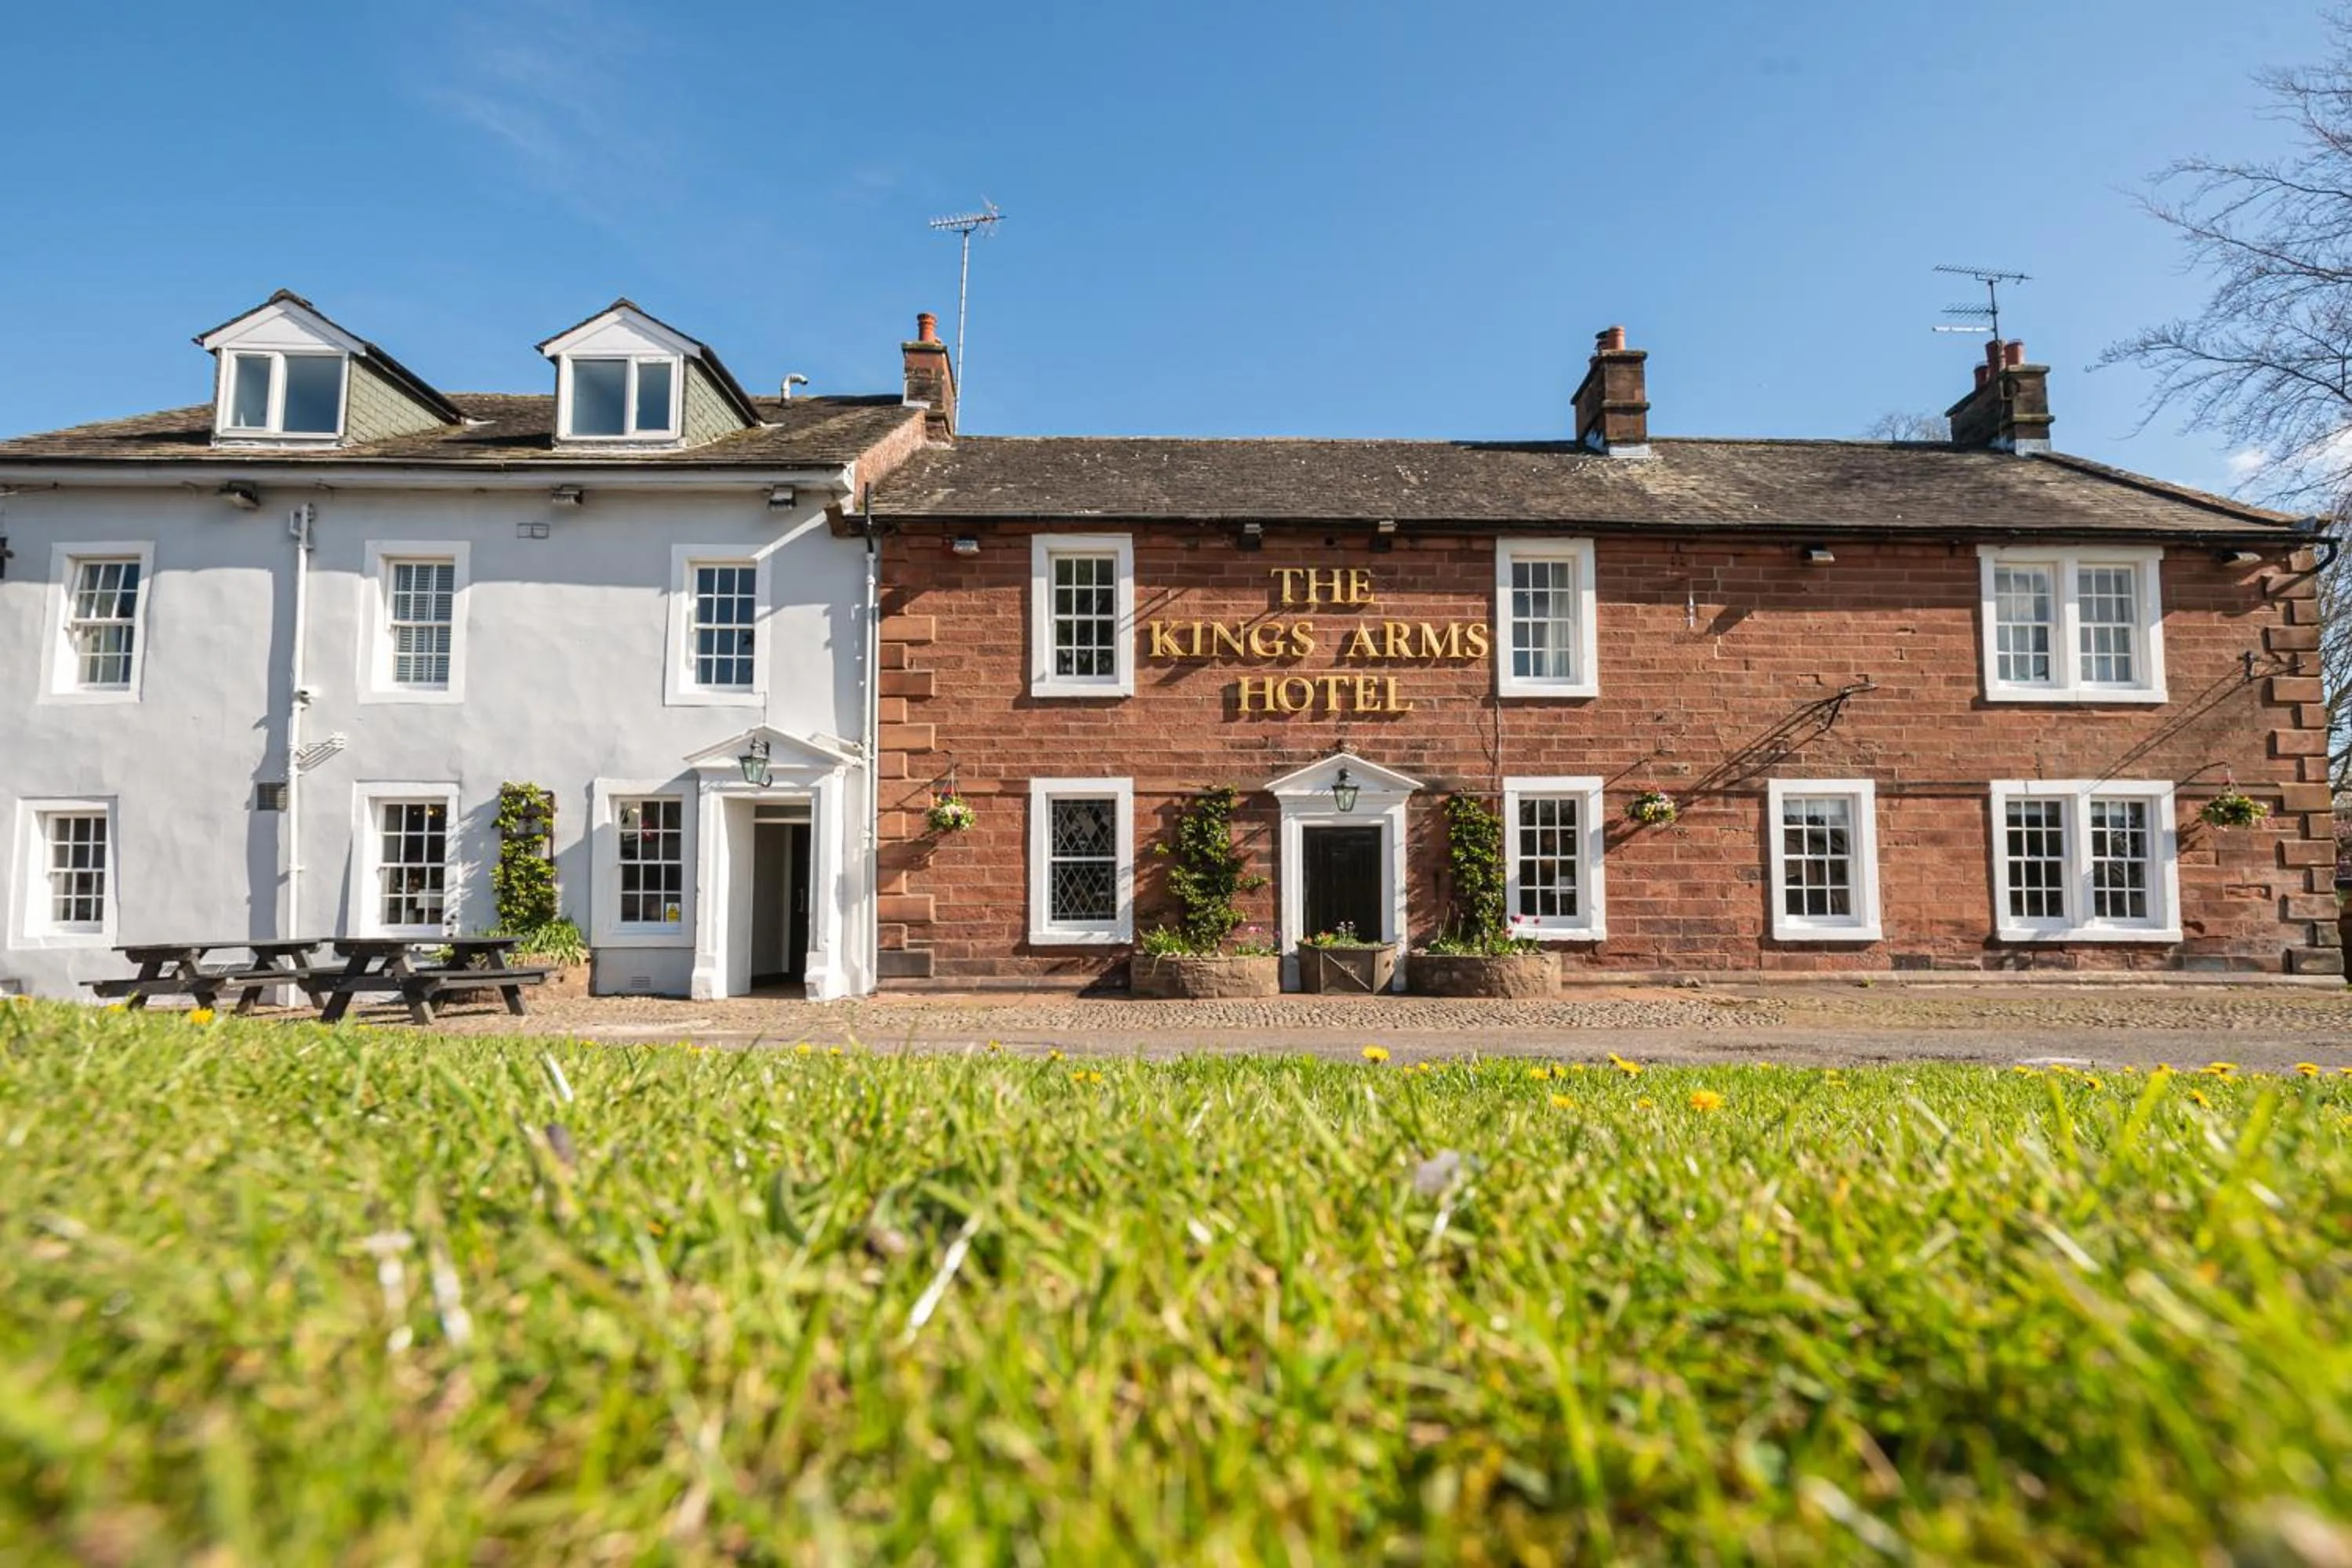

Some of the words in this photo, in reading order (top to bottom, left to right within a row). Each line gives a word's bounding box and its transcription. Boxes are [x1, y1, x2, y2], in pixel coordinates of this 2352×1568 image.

[1271, 568, 1374, 604] THE
[1149, 620, 1315, 658] KINGS
[1348, 622, 1488, 659] ARMS
[1238, 676, 1414, 713] HOTEL
